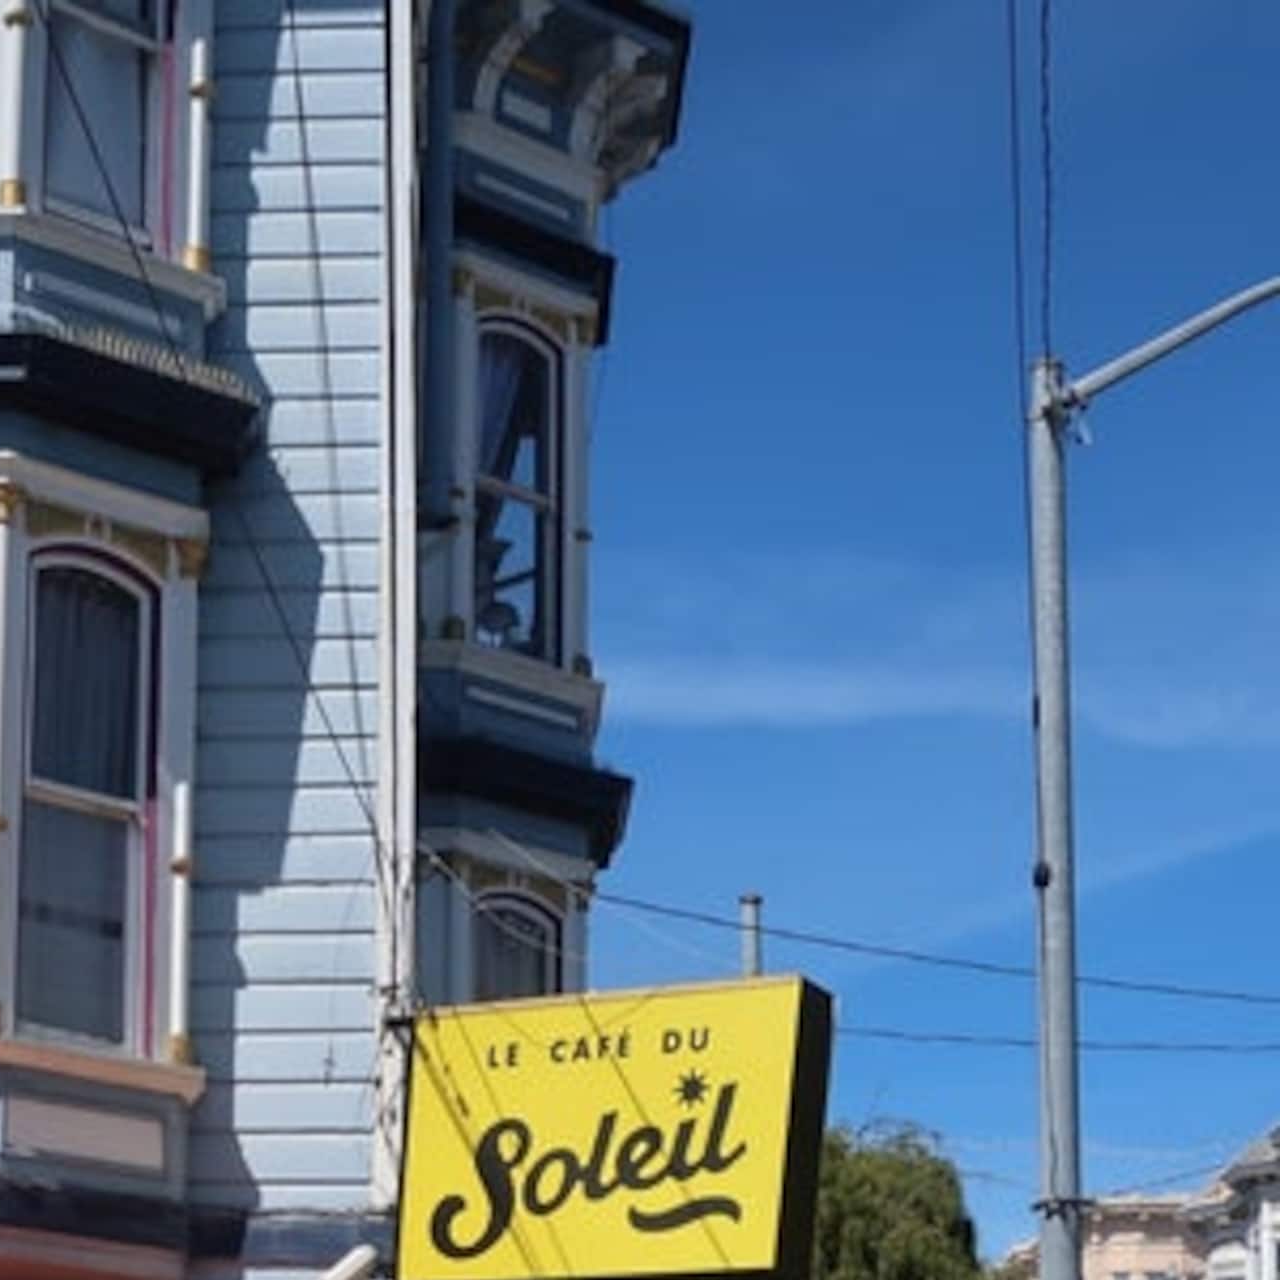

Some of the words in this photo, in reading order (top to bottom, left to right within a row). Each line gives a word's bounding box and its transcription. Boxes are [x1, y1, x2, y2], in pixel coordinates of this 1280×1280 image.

[487, 1043, 519, 1068] LE
[549, 1025, 630, 1063] CAFÉ
[662, 1028, 710, 1054] DU
[430, 1068, 747, 1259] Soleil
